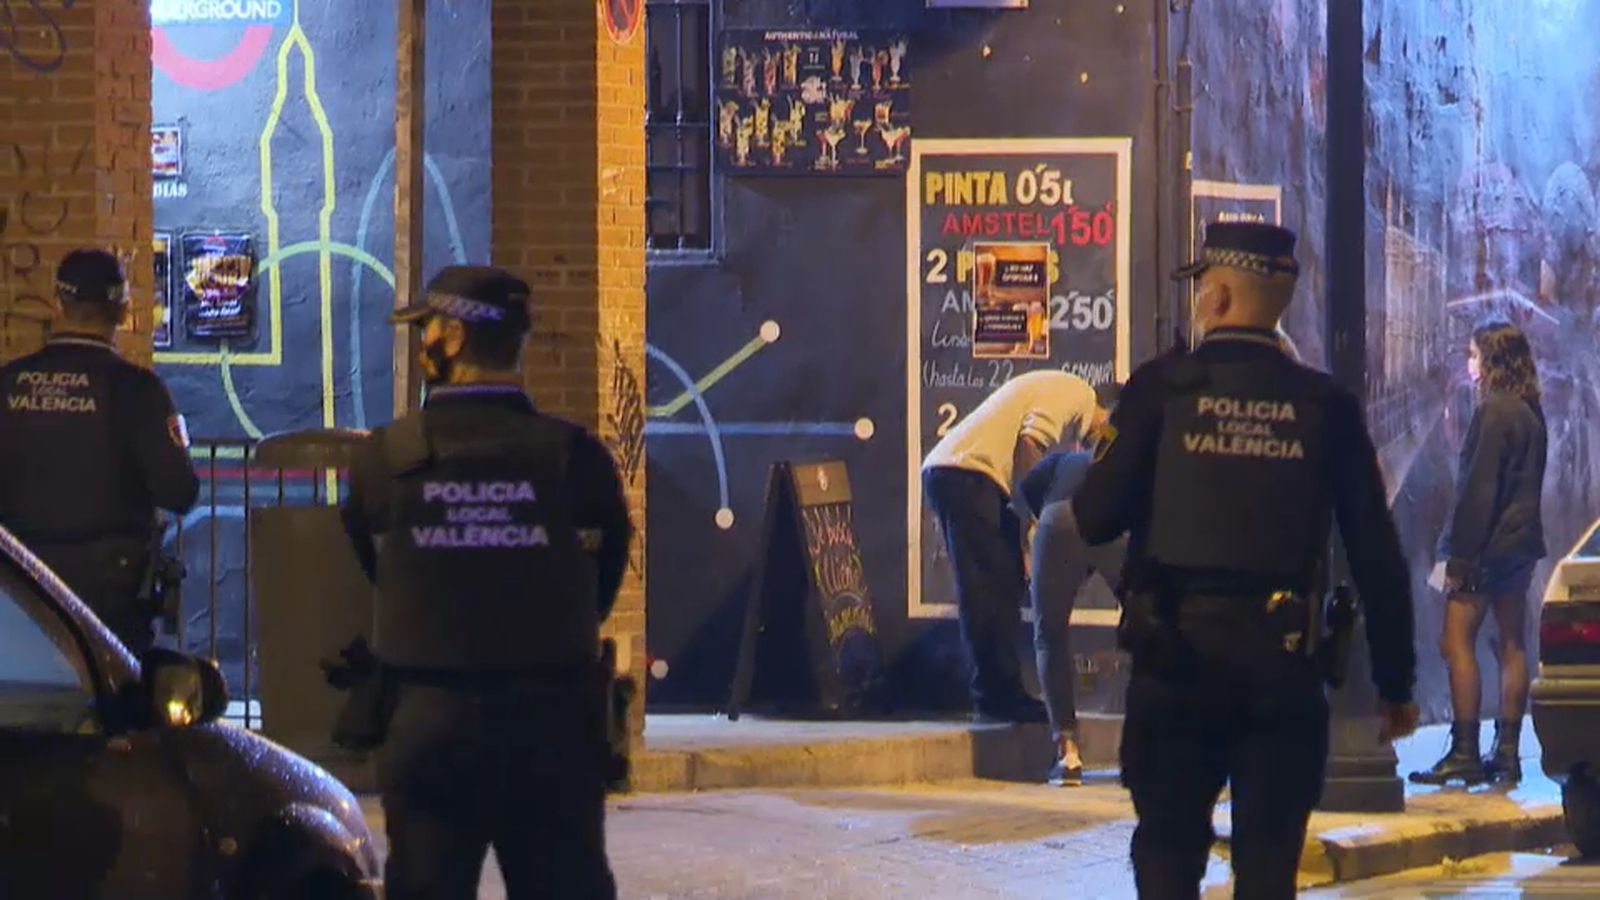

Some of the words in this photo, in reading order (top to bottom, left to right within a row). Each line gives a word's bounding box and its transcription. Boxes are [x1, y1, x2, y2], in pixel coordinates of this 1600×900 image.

[925, 170, 1008, 205] PINTA
[943, 211, 1050, 238] AMSTEL
[925, 248, 948, 283] 2
[16, 371, 89, 387] POLICIA
[1197, 396, 1297, 421] POLICIA
[1218, 420, 1273, 437] LOCAL
[423, 480, 536, 503] POLICIA
[447, 507, 512, 522] LOCAL
